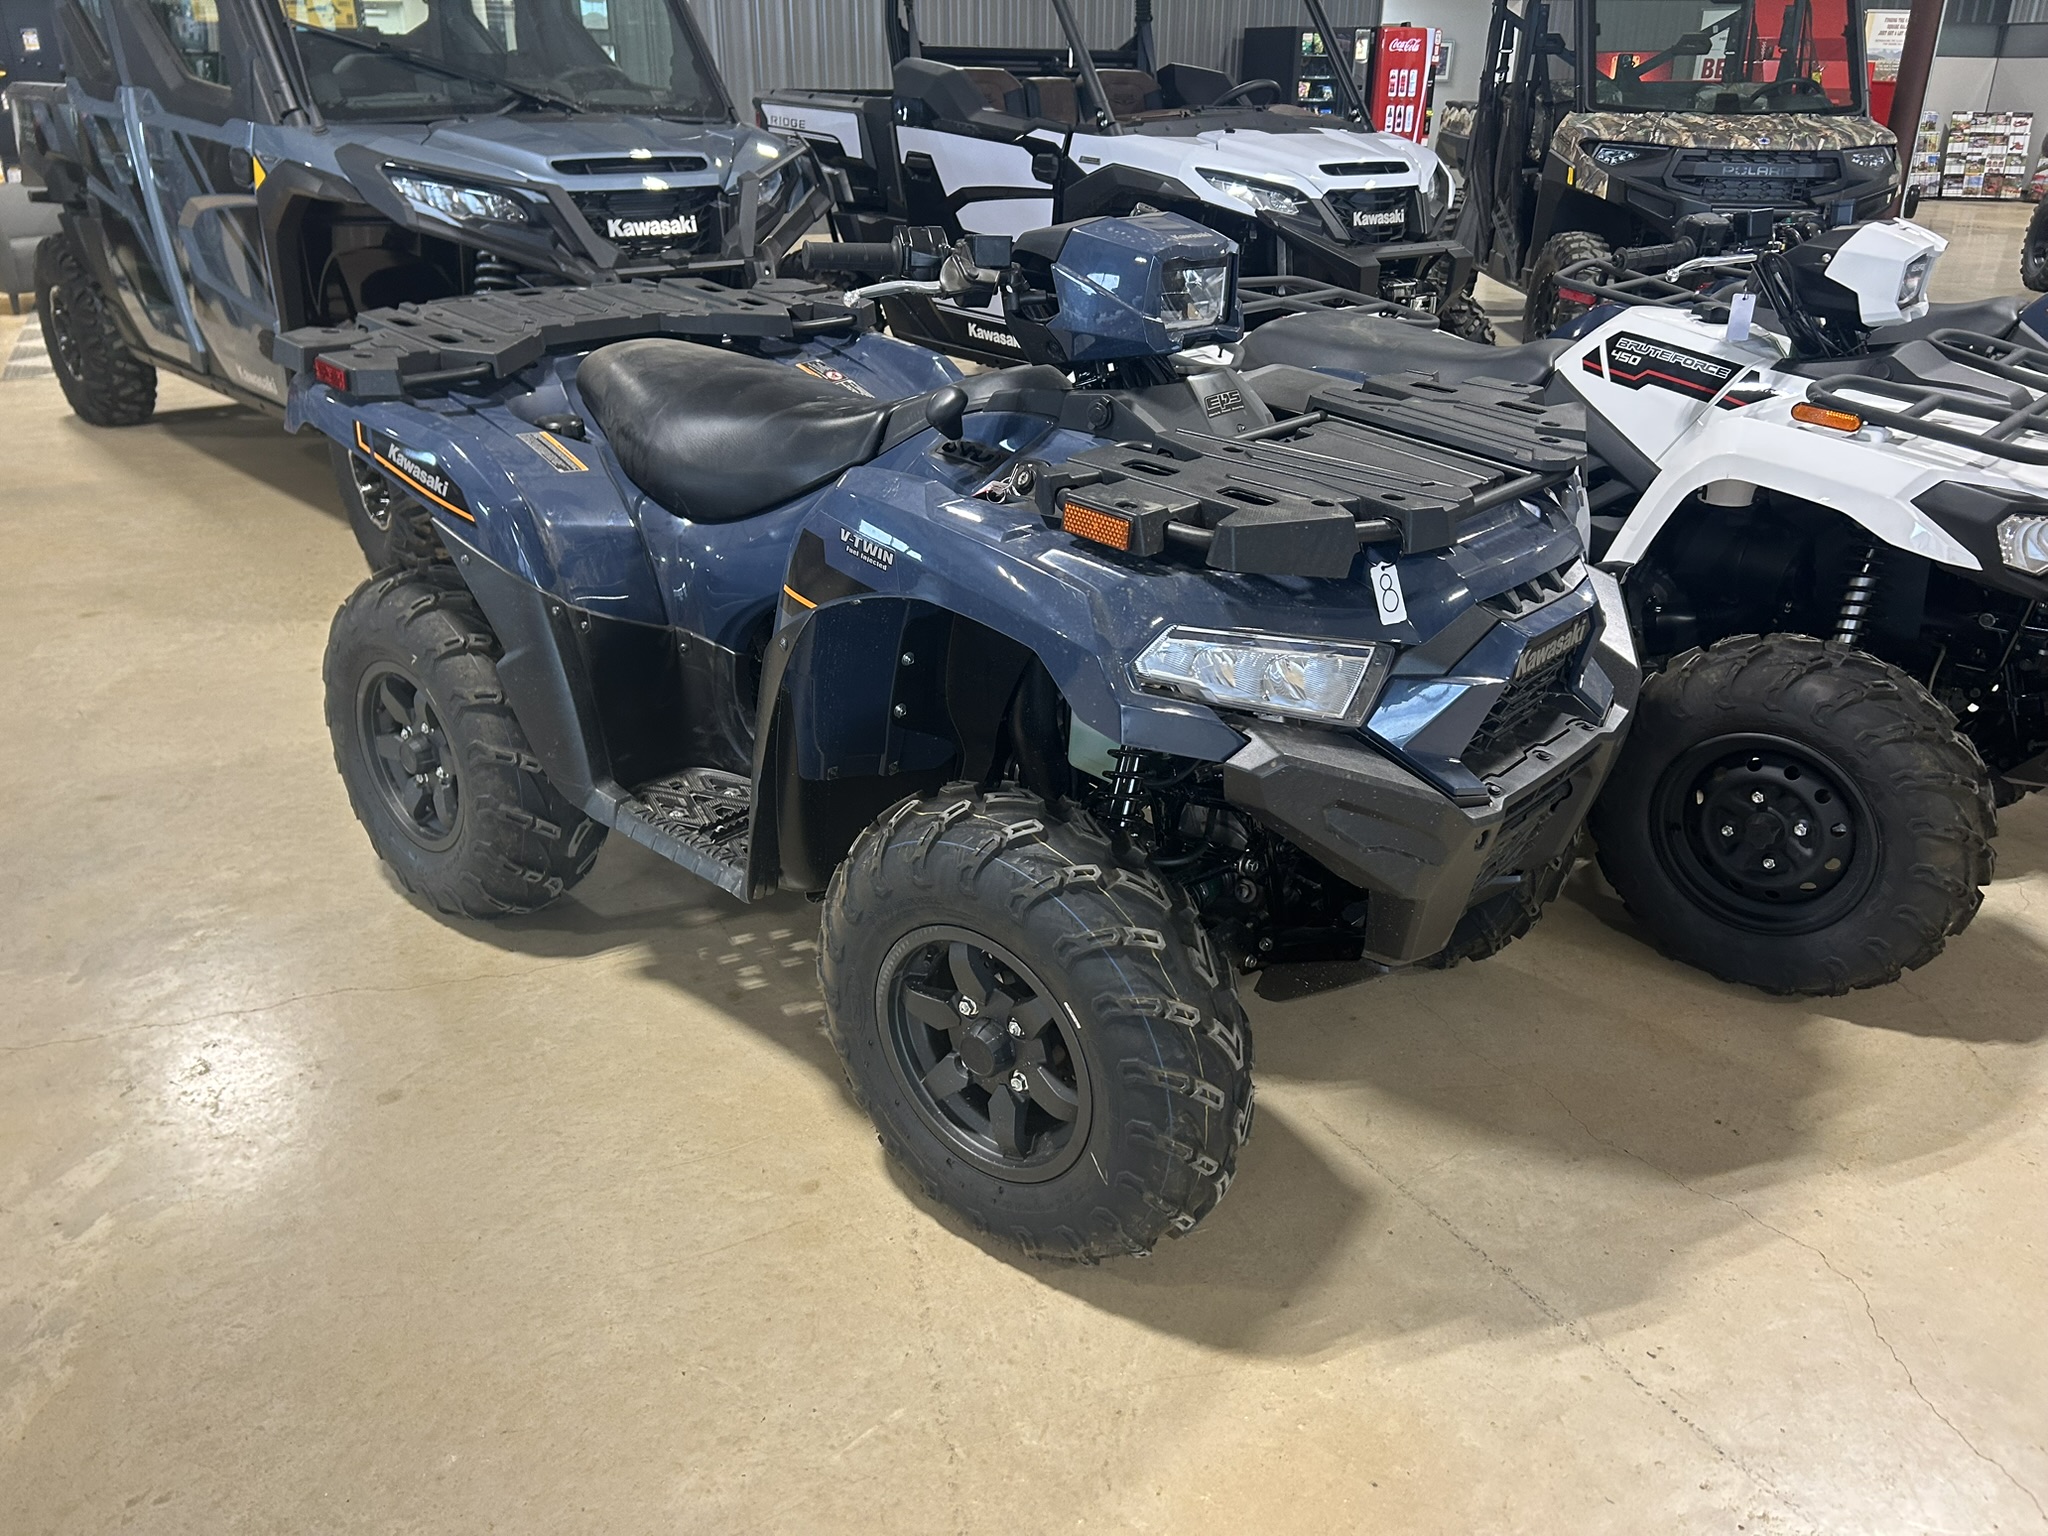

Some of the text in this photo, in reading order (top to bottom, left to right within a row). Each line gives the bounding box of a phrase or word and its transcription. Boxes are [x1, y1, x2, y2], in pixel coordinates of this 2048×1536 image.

[770, 116, 806, 129] RIDGE
[1722, 166, 1796, 176] POLARIS
[607, 214, 698, 238] Kawasaki
[1353, 208, 1405, 226] Kawasaki
[1611, 349, 1642, 366] 450
[388, 443, 449, 497] Kawasaki
[840, 527, 894, 566] V-TWIN
[1380, 573, 1400, 613] 8
[1515, 618, 1587, 679] Kawasaki
